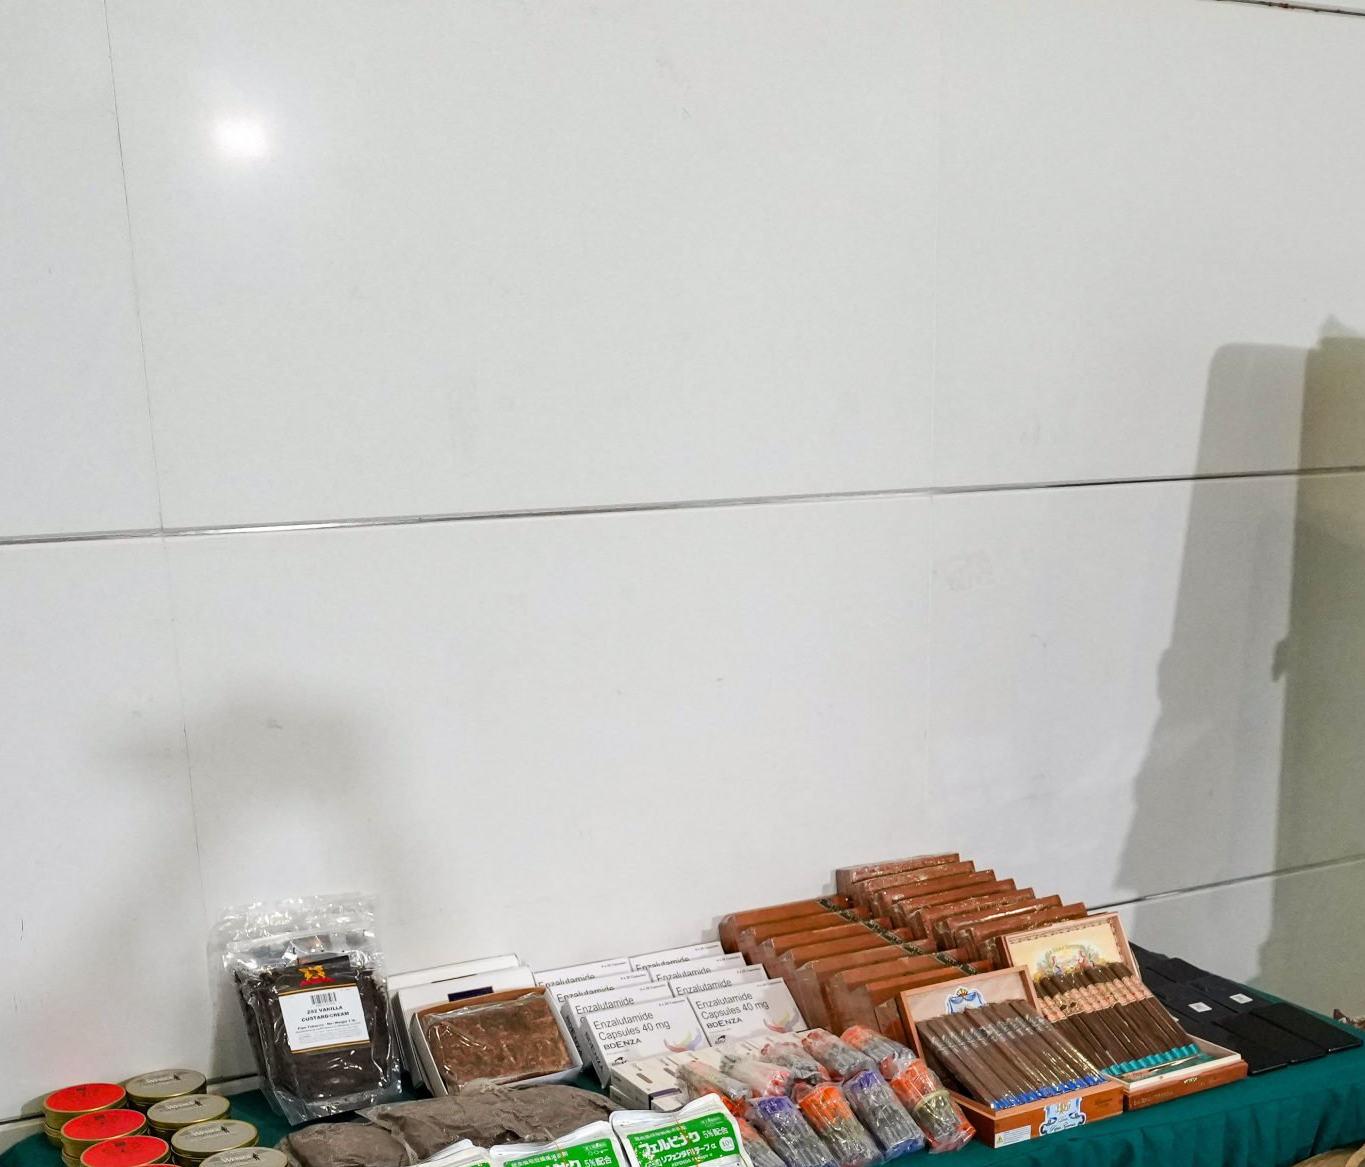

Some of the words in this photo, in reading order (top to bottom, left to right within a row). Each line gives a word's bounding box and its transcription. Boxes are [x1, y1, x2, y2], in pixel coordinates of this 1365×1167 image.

[676, 979, 733, 996] Enzalutamide
[575, 997, 635, 1015] Enzalutamide
[696, 992, 753, 1010] Enzalutamide
[701, 1006, 742, 1021] Capsules
[742, 1002, 754, 1011] 40
[754, 1000, 770, 1011] mg
[593, 1012, 654, 1030] Enzalutamide
[598, 1027, 641, 1042] Capsules
[642, 1022, 654, 1032] 40
[656, 1020, 671, 1031] mg
[603, 1038, 642, 1050] BDENZA
